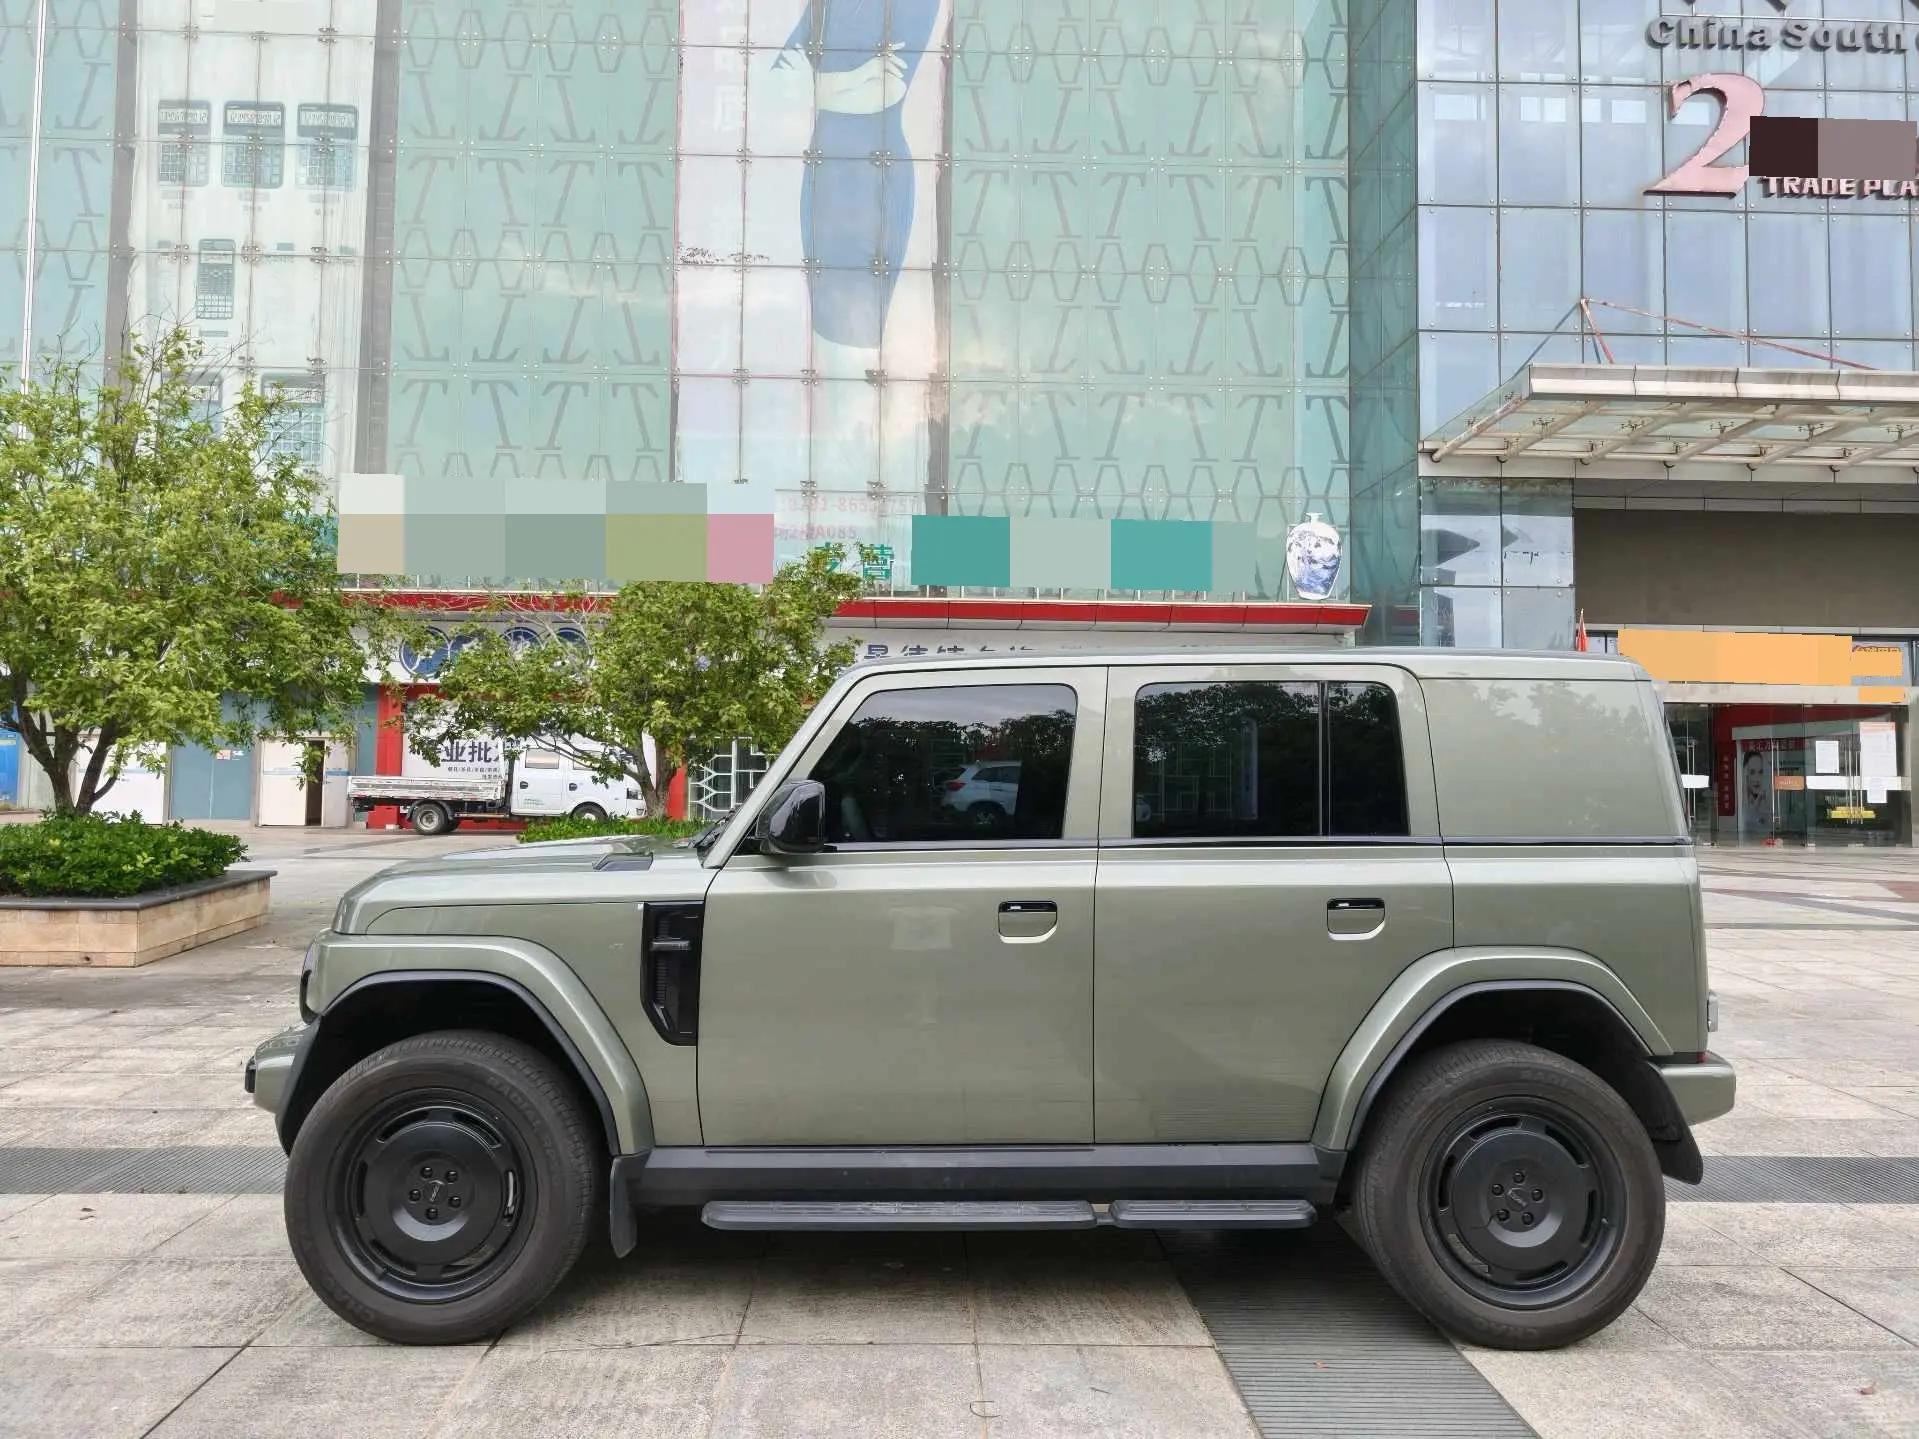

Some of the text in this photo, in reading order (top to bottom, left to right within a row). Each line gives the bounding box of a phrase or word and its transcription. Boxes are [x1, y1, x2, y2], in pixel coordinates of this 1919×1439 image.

[1646, 17, 1772, 50] China
[1780, 19, 1907, 53] South
[1643, 72, 1766, 197] 2
[1760, 176, 1857, 199] TRADE
